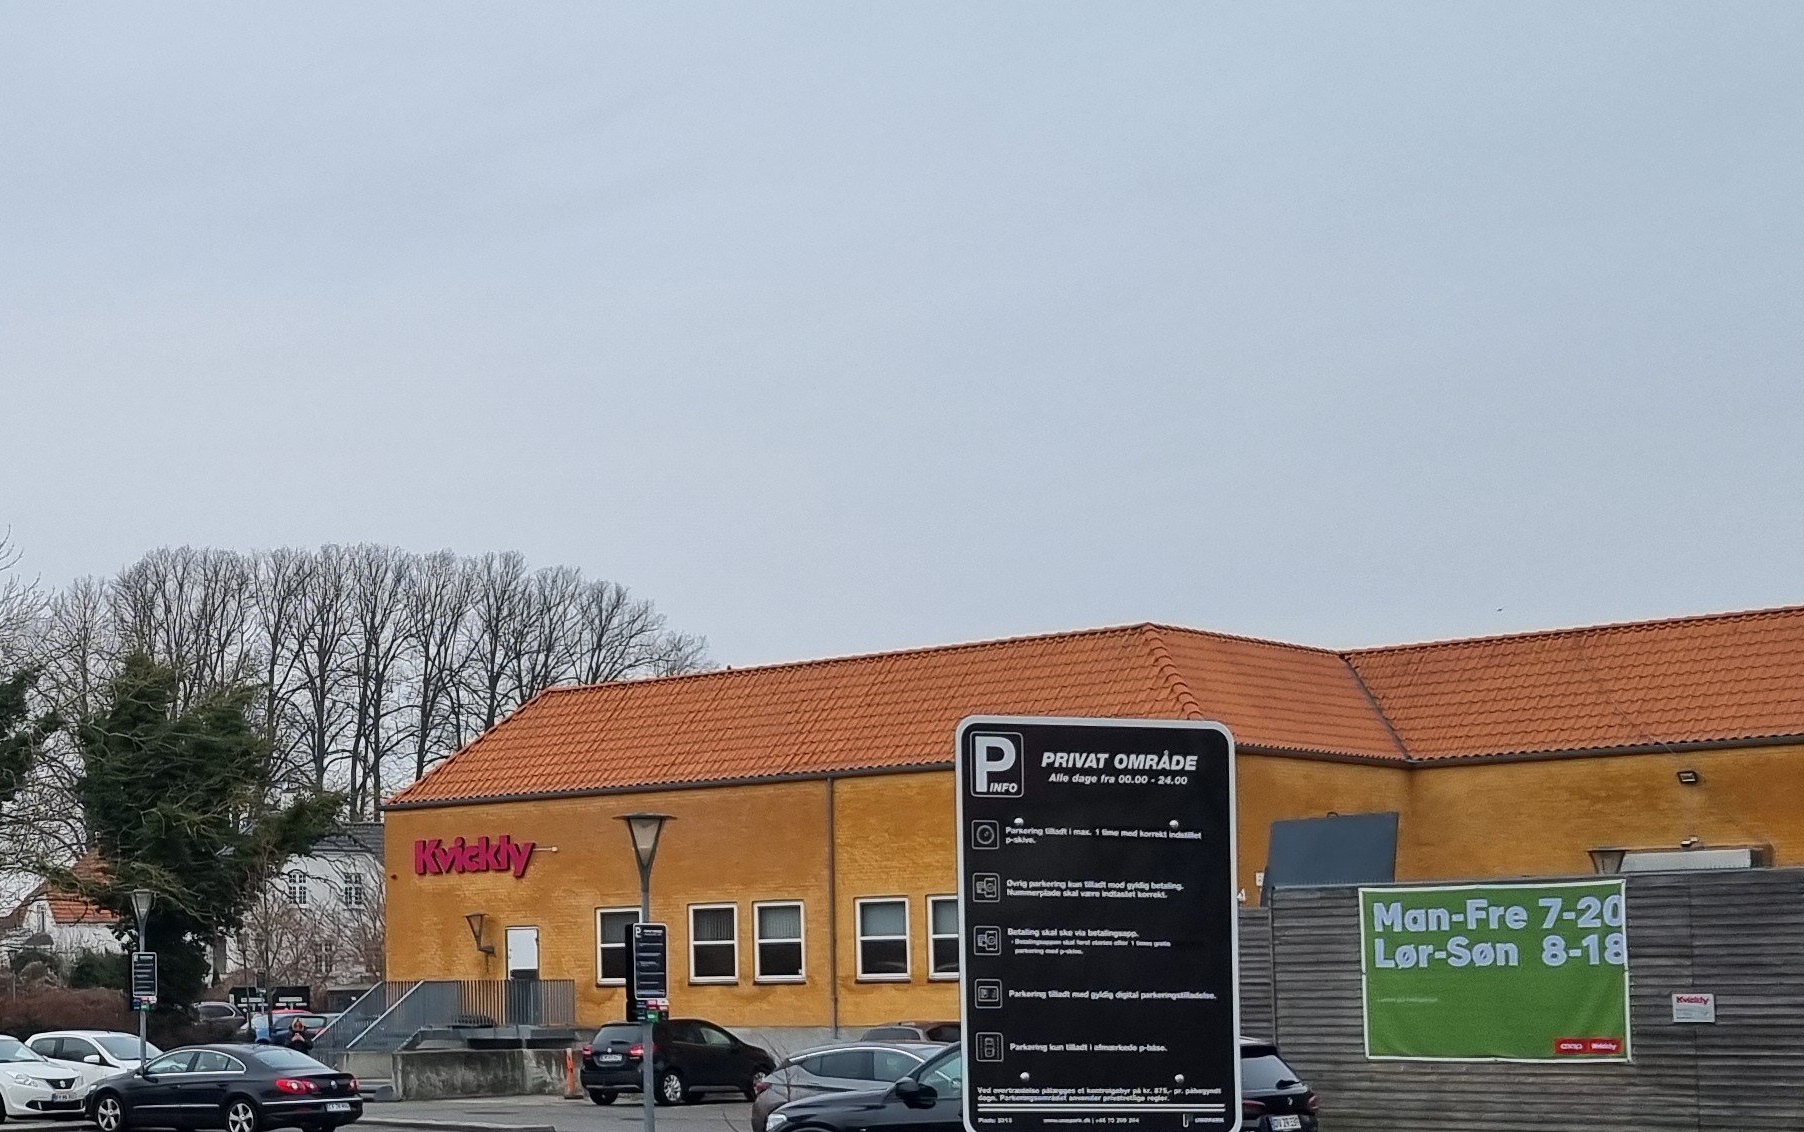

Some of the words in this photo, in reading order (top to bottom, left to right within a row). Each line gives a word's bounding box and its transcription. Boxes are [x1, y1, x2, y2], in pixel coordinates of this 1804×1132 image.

[975, 736, 1016, 793] P
[1041, 751, 1109, 769] PRIVAT
[1113, 749, 1198, 771] OMRÅDE
[989, 782, 1018, 793] INFO
[1048, 773, 1070, 783] Alle
[1071, 773, 1098, 785] dage
[1100, 774, 1116, 784] fra
[1118, 774, 1149, 785] 00.00
[1157, 775, 1189, 785] 24.00
[1005, 826, 1044, 837] Parkering
[414, 834, 537, 879] Kvickly
[1373, 899, 1528, 932] Man-Fre
[1538, 894, 1623, 929] 7-20
[1374, 936, 1519, 969] Lør-Søn
[1541, 932, 1625, 967] 8-18
[1008, 989, 1047, 1000] Parkering
[1071, 990, 1090, 999] med
[1090, 990, 1114, 1000] gyldig
[1115, 991, 1140, 1000] digital
[1009, 1042, 1048, 1053] Parkering
